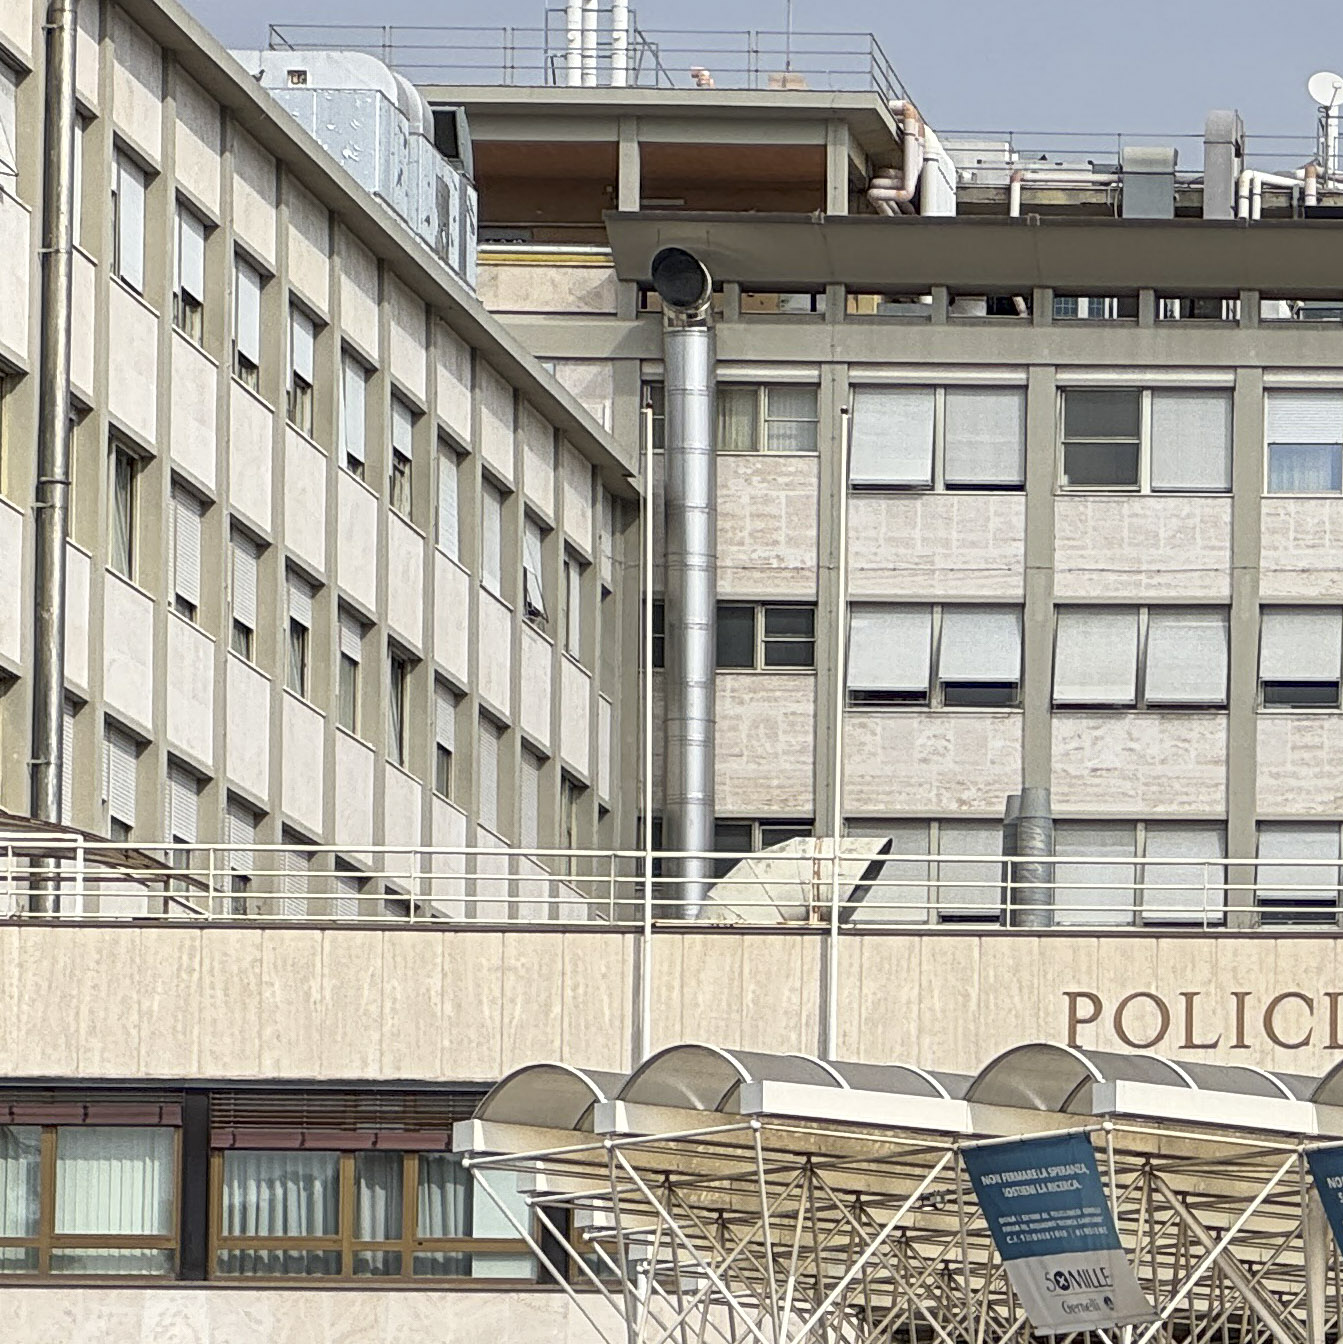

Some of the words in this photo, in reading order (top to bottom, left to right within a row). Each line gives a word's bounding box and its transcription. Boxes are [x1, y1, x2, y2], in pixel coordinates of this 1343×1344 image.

[981, 1174, 1002, 1186] NON
[1002, 1169, 1037, 1183] FERMARE
[1037, 1168, 1048, 1178] LA
[1036, 1183, 1047, 1193] LA
